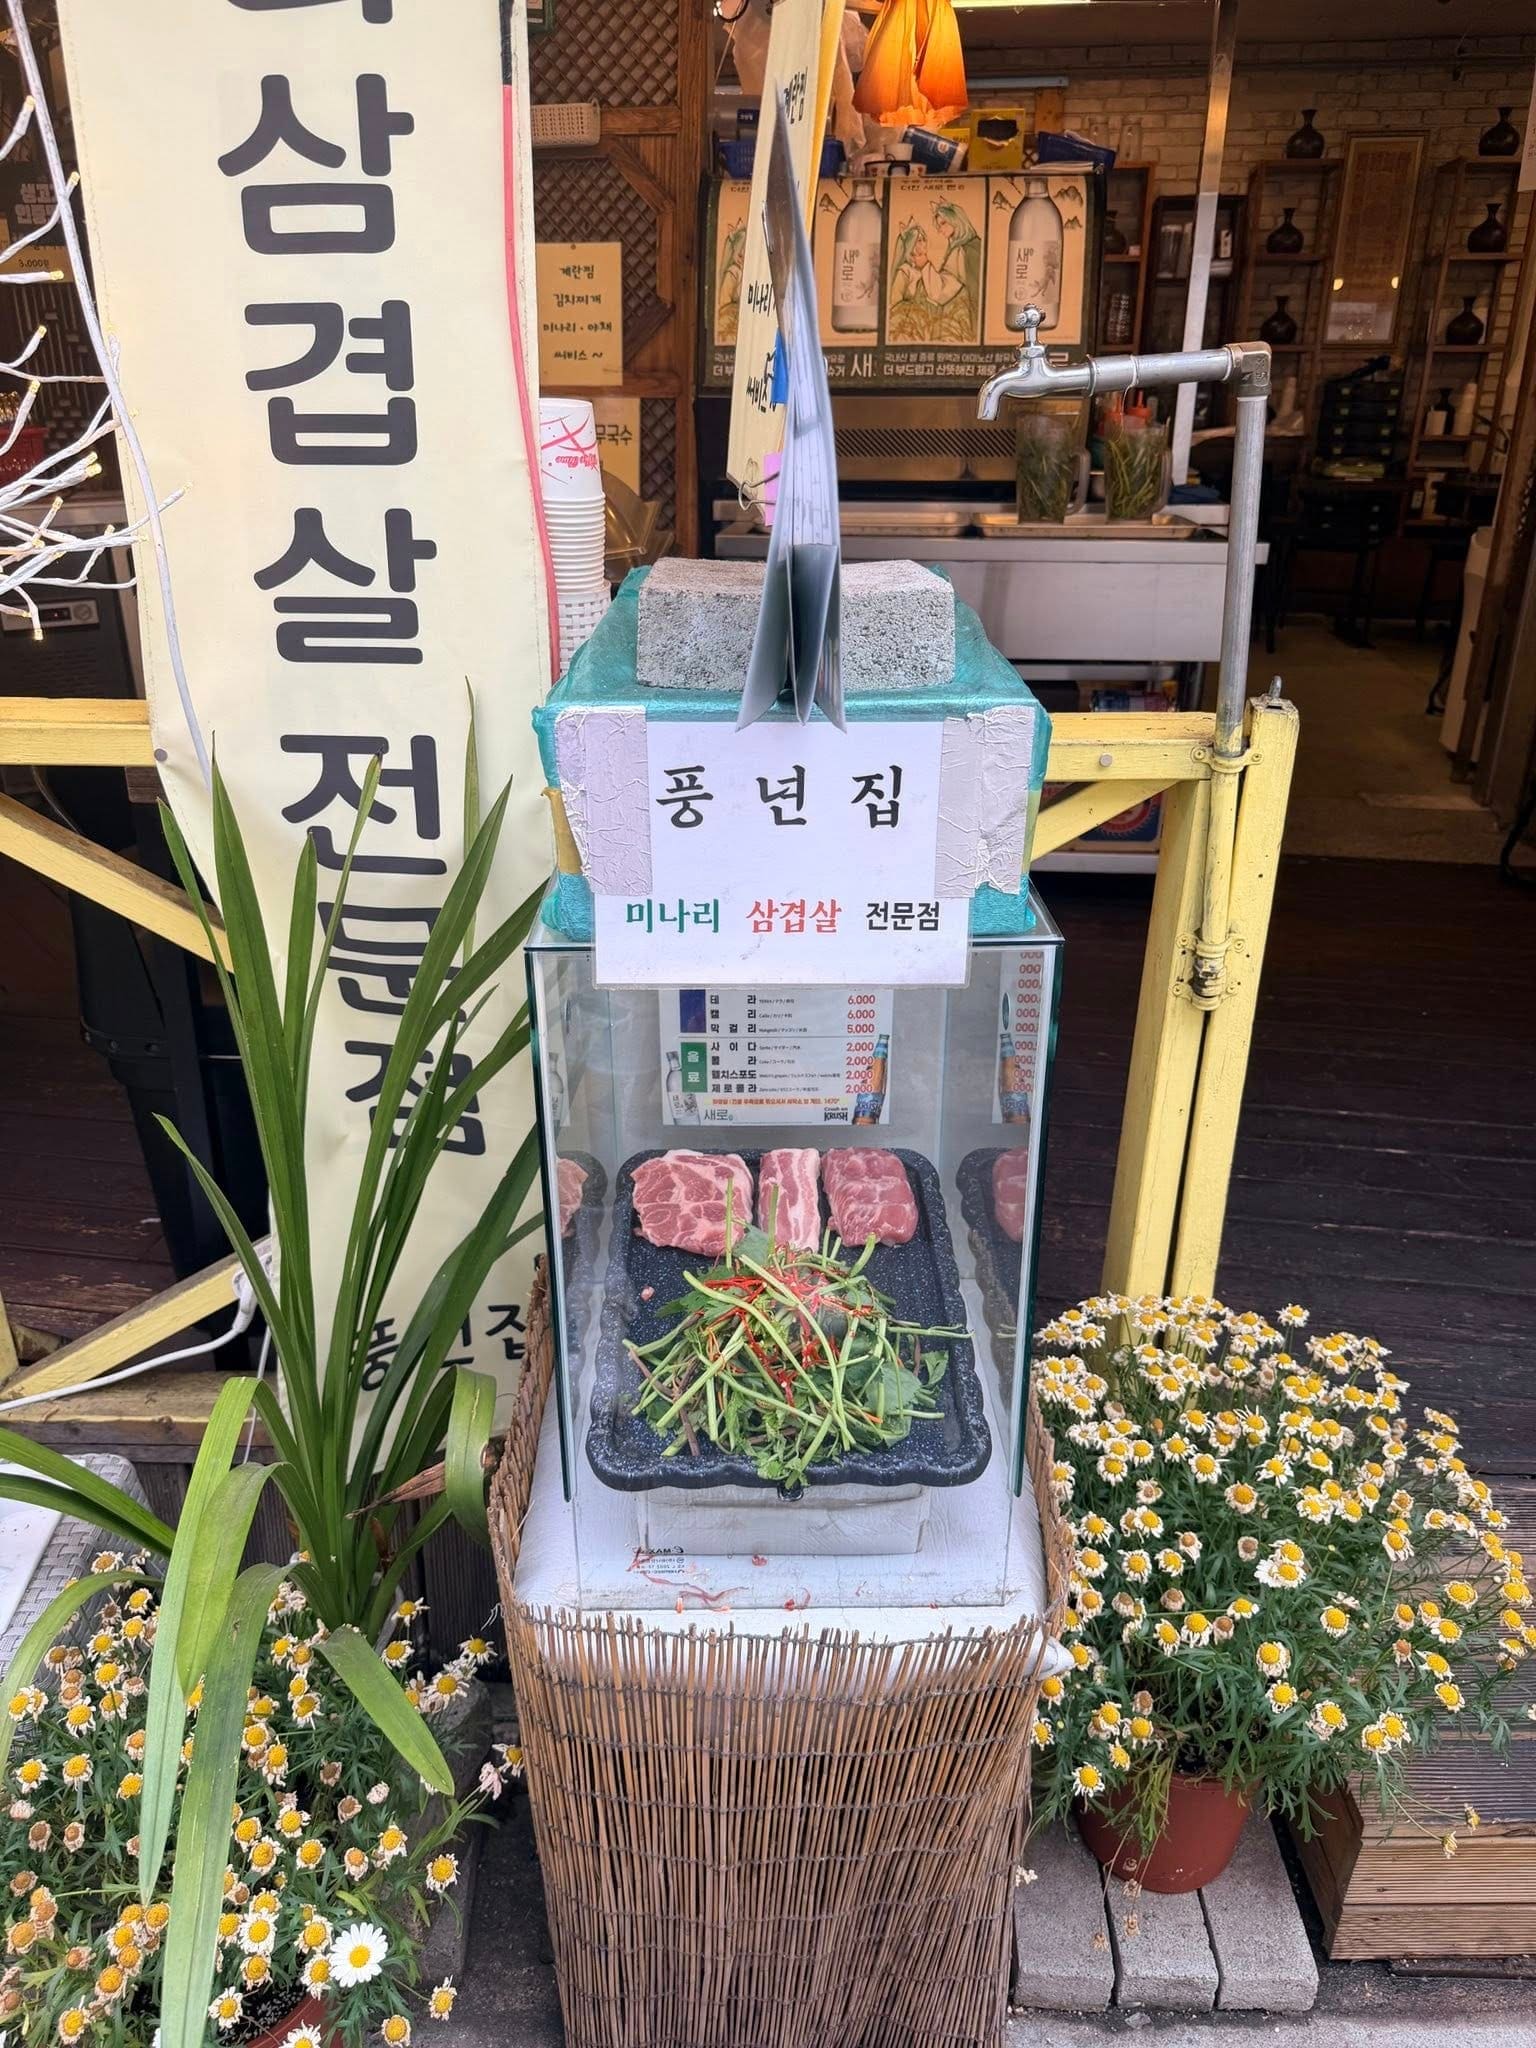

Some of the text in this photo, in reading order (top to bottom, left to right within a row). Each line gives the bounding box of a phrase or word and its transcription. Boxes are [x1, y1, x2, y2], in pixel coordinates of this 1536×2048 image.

[560, 264, 595, 280] 계란찜
[553, 293, 602, 308] 김치찌개
[543, 321, 576, 333] 미나리
[218, 74, 438, 665] 삼겹살
[884, 364, 894, 377] 더
[895, 364, 934, 377] 부드럽고
[625, 898, 941, 934] 미나리 삼겹살 전문점
[824, 1110, 848, 1122] KRUSH
